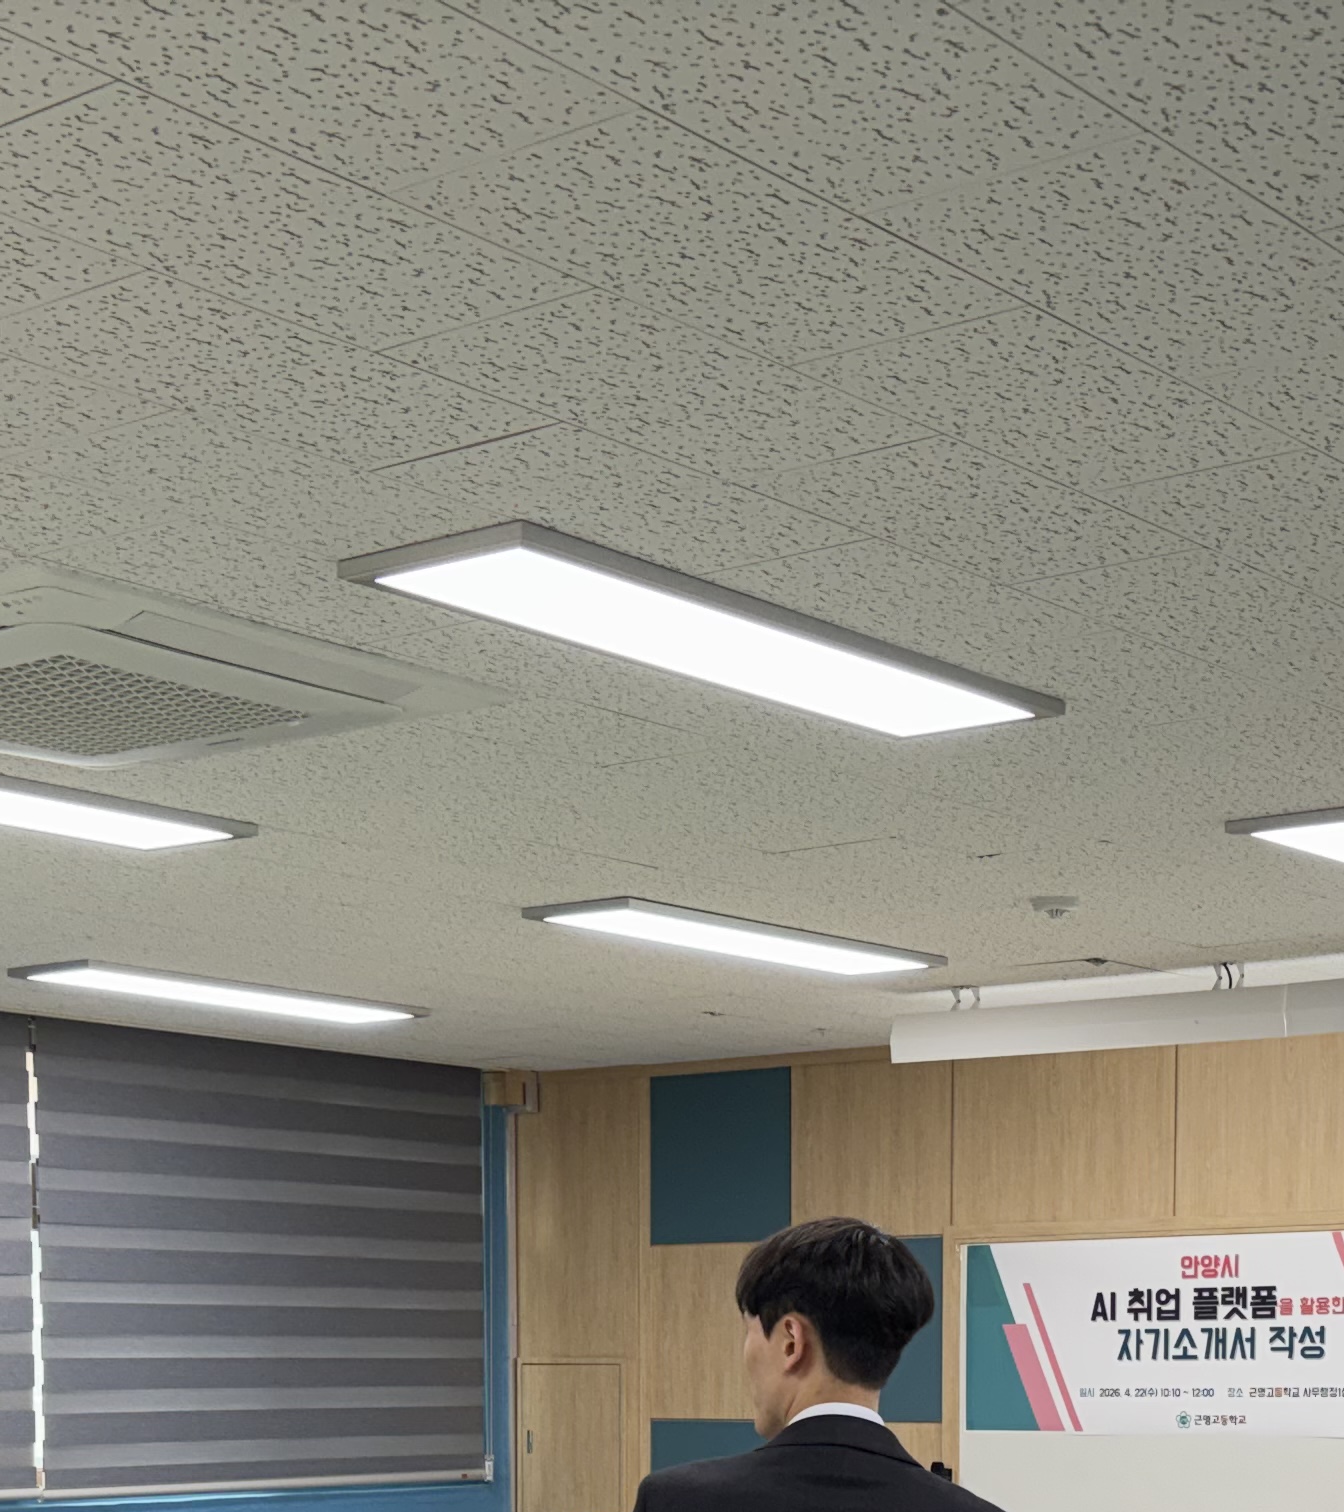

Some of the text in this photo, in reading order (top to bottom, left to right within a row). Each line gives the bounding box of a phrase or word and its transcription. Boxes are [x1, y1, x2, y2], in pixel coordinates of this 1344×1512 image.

[1180, 1254, 1239, 1279] 안양시
[1091, 1292, 1116, 1321] AI
[1127, 1287, 1181, 1321] 취업
[1192, 1285, 1293, 1320] 플랫폼을
[1117, 1326, 1326, 1361] 자기소개서 작성
[1079, 1388, 1095, 1398] 일시
[1099, 1388, 1122, 1398] 2026.
[1134, 1387, 1158, 1399] 22(수)
[1160, 1388, 1181, 1398] 10:10
[1192, 1388, 1215, 1398] 12:00
[1227, 1388, 1243, 1398] 장소
[1249, 1387, 1300, 1398] 근명고등학교
[1194, 1415, 1247, 1426] 근명고등학교
